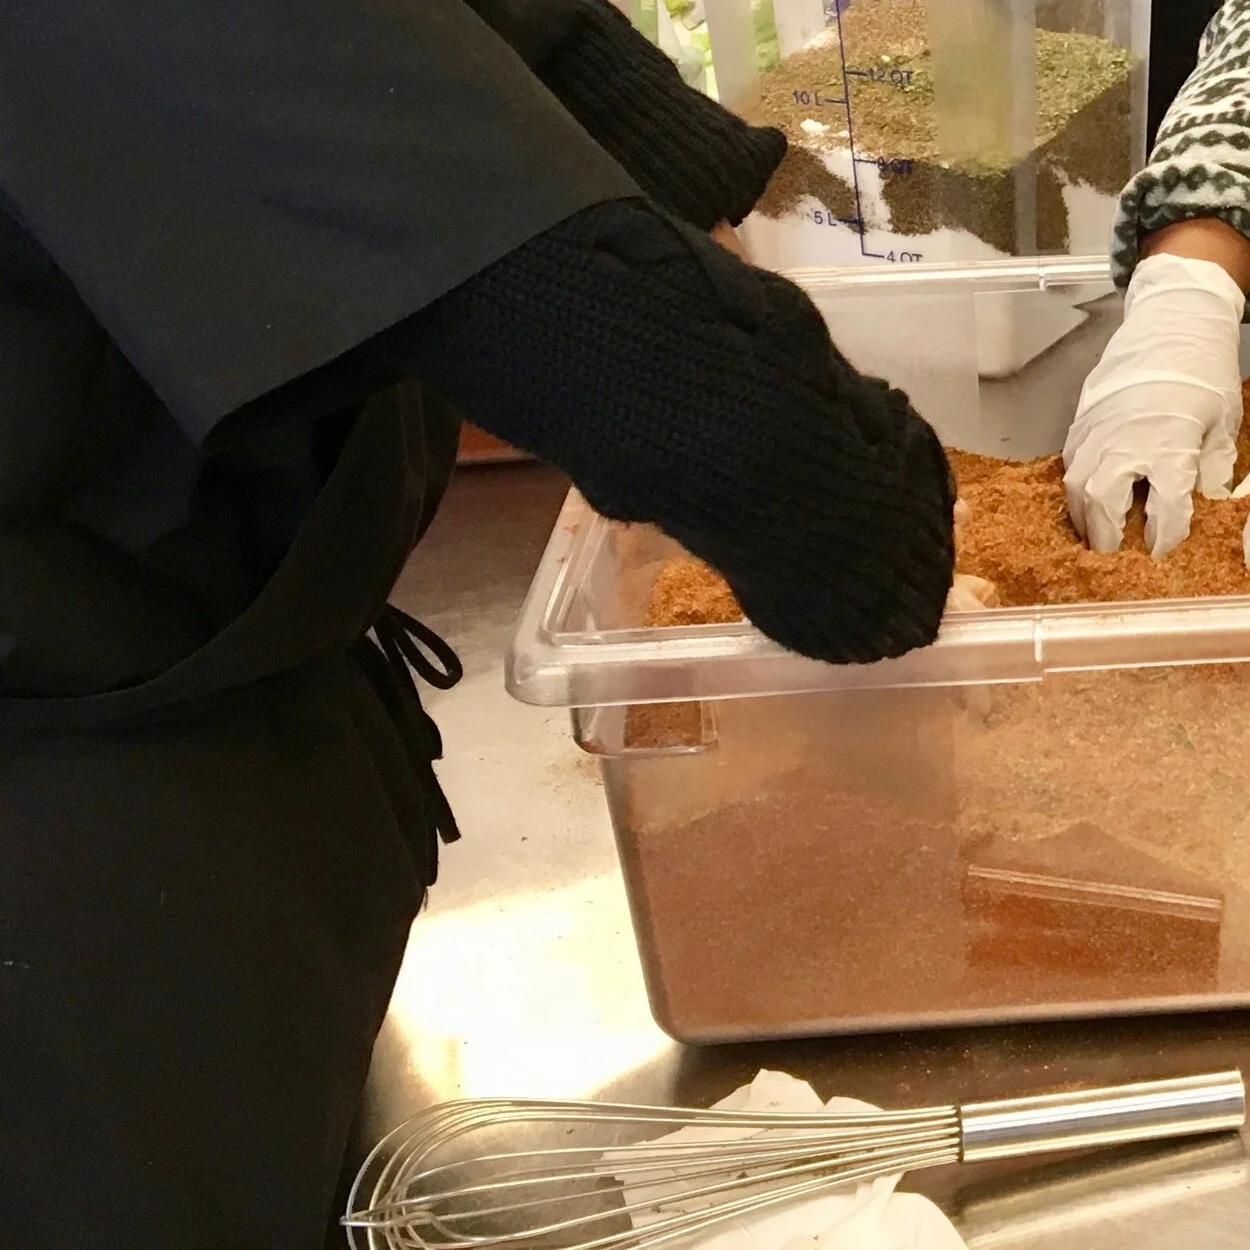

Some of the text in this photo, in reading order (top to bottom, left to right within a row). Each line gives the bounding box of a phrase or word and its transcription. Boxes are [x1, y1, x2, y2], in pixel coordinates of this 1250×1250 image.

[867, 68, 914, 85] 12 QT
[793, 90, 823, 106] 10 L
[877, 156, 915, 174] 8 QT
[814, 211, 837, 226] 5 L
[886, 251, 895, 262] 4
